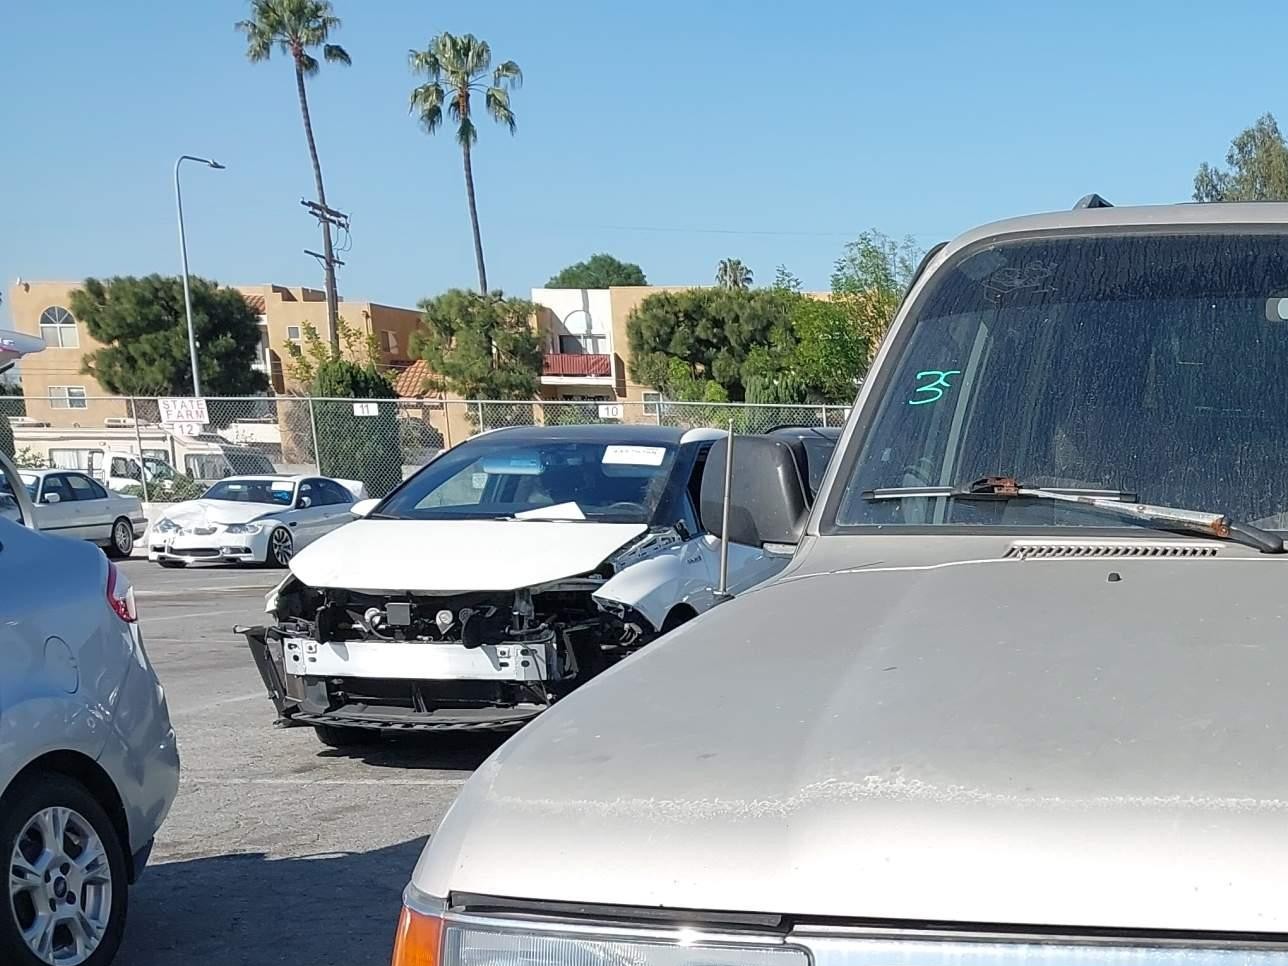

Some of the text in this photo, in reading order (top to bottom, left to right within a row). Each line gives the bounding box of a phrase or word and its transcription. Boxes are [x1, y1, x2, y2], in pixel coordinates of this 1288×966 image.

[162, 400, 205, 410] STATE
[359, 404, 369, 414] 11
[166, 410, 205, 420] FARM
[604, 406, 618, 416] 10
[179, 423, 194, 435] 12
